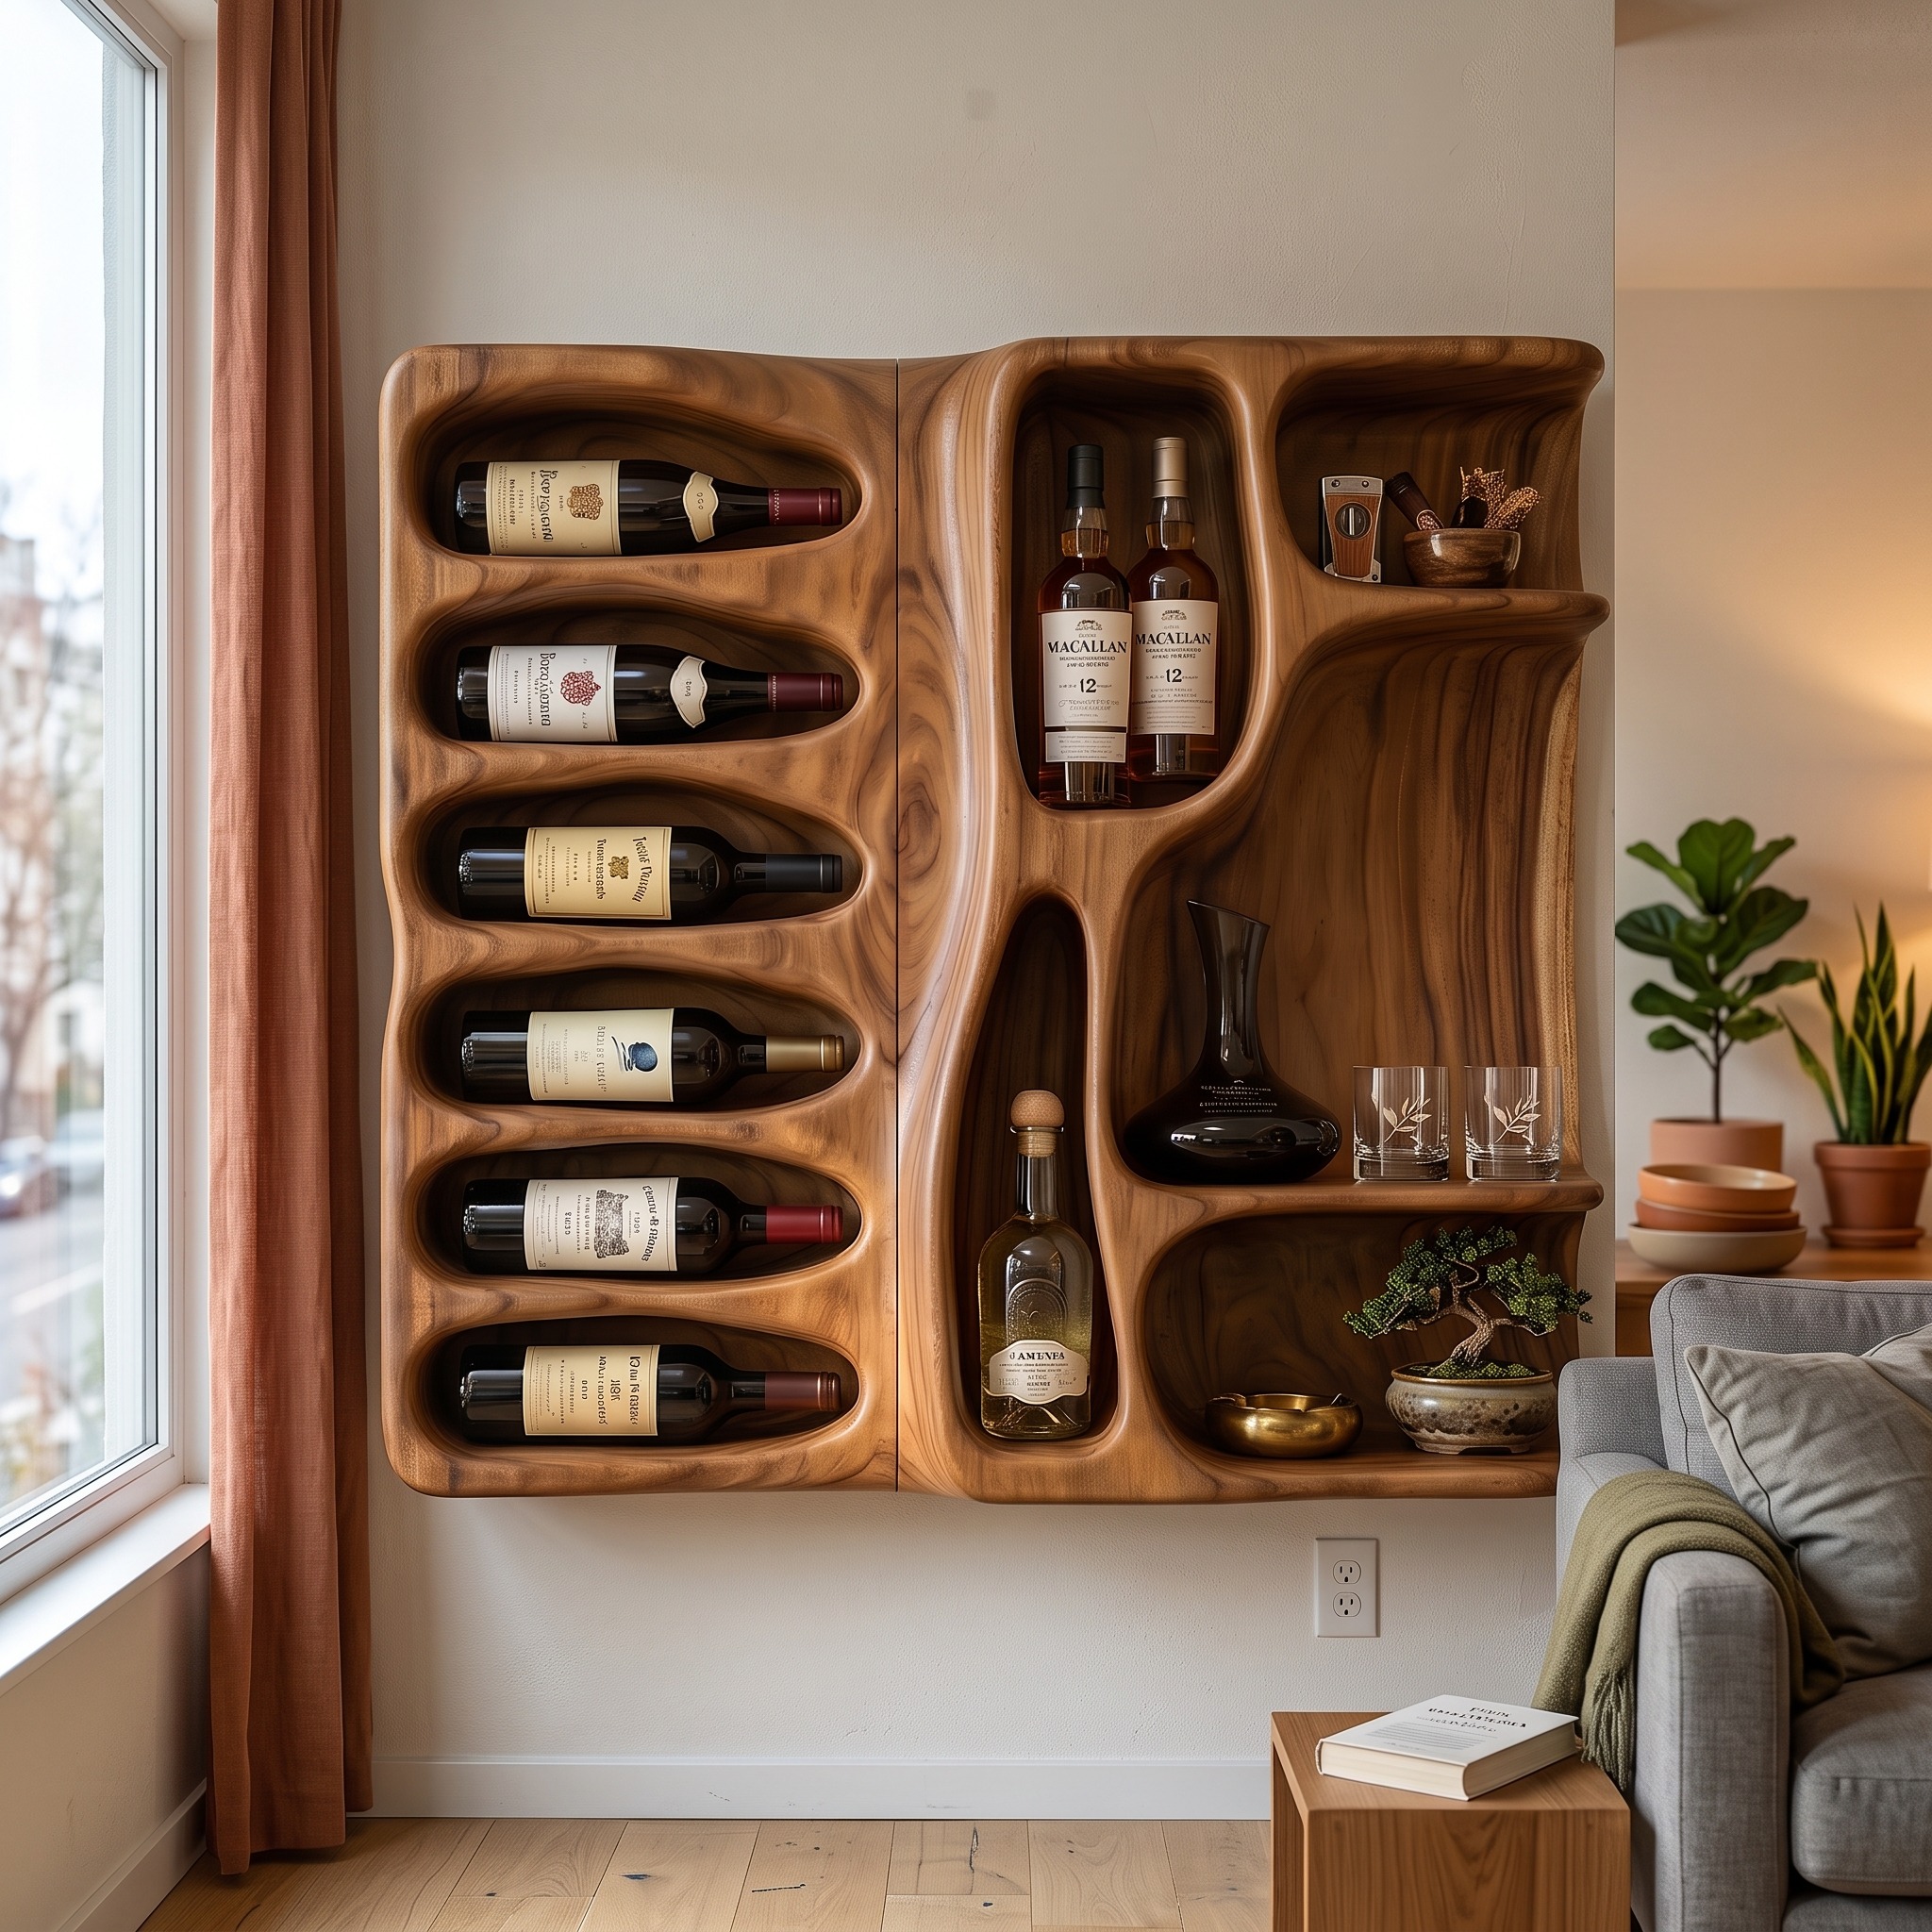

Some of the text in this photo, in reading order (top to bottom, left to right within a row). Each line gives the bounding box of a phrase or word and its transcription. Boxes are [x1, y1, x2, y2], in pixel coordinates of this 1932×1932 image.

[1135, 632, 1211, 645] MACALLAN
[1047, 641, 1127, 654] MACALLAN
[1165, 668, 1183, 683] 12
[1079, 678, 1097, 693] 12
